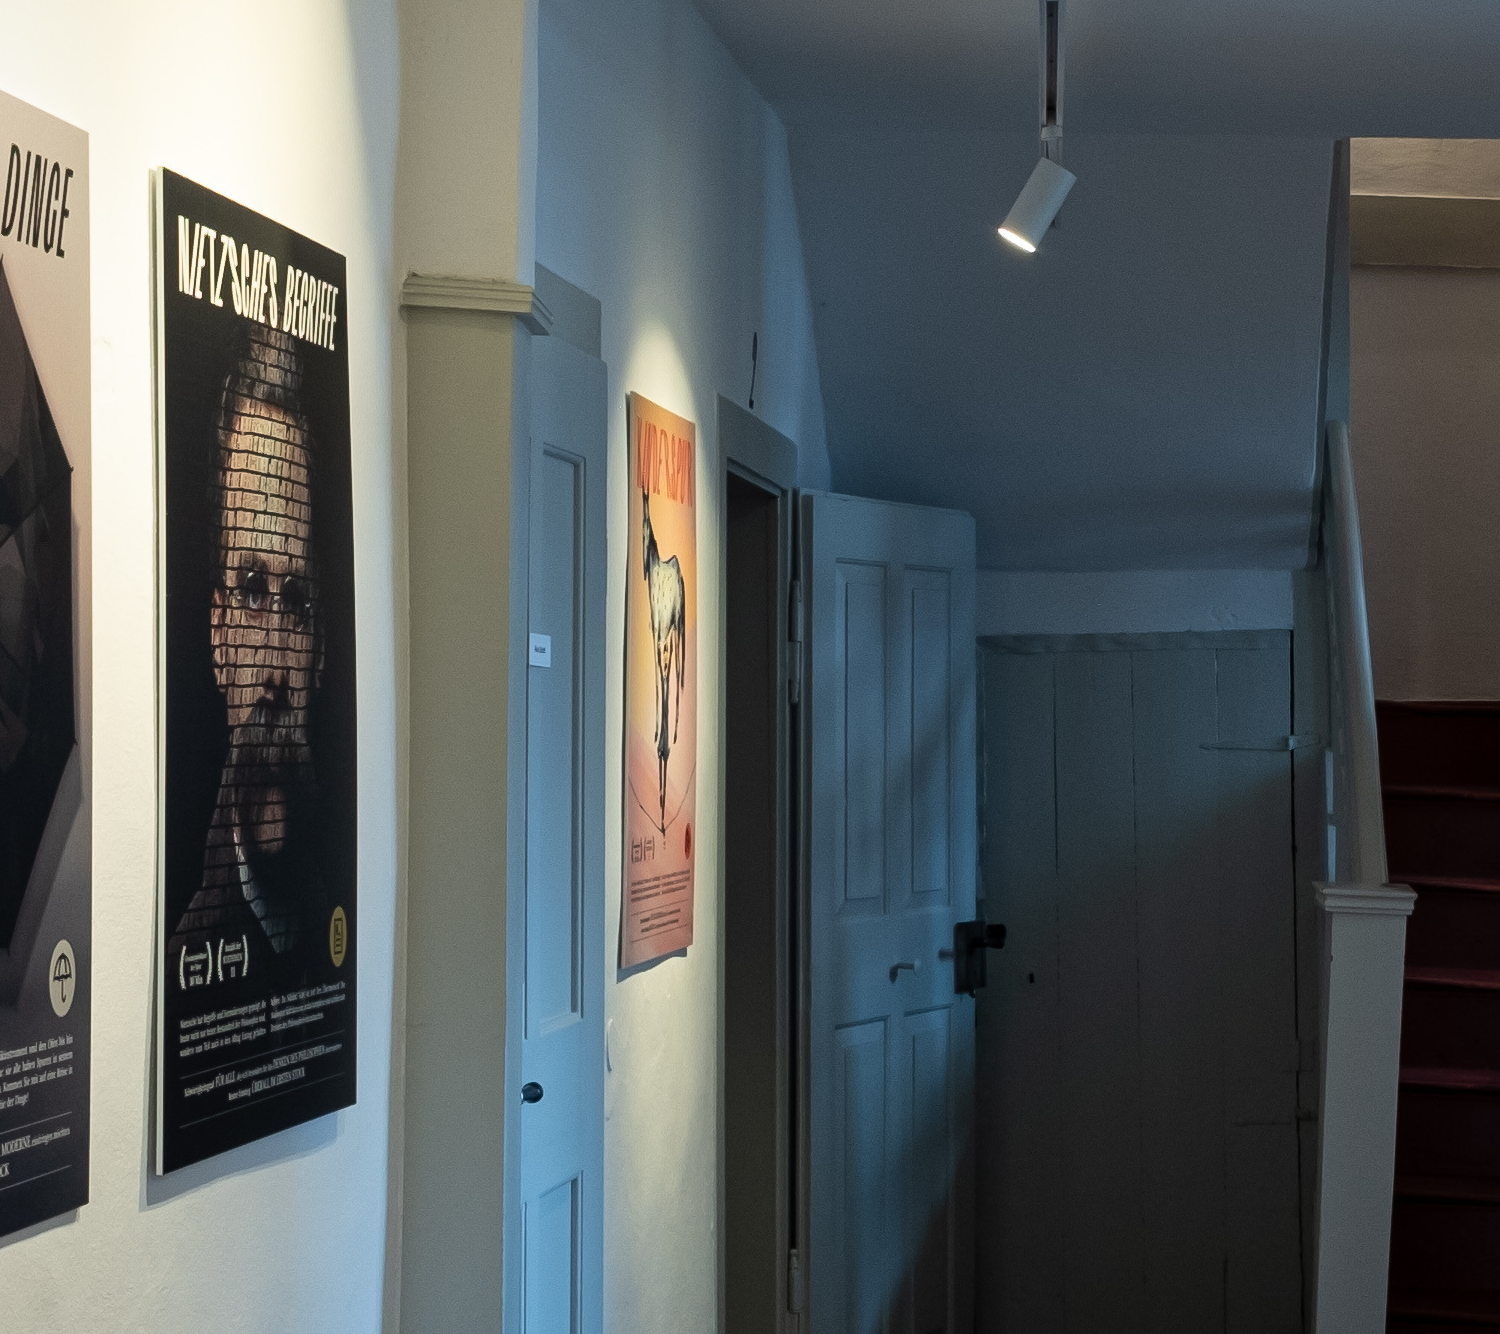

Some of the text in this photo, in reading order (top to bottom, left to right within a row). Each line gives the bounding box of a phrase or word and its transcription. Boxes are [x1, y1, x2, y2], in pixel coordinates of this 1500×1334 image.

[1, 143, 73, 258] DINGE
[178, 215, 338, 351] NIETZSCHES BEGRIFFE
